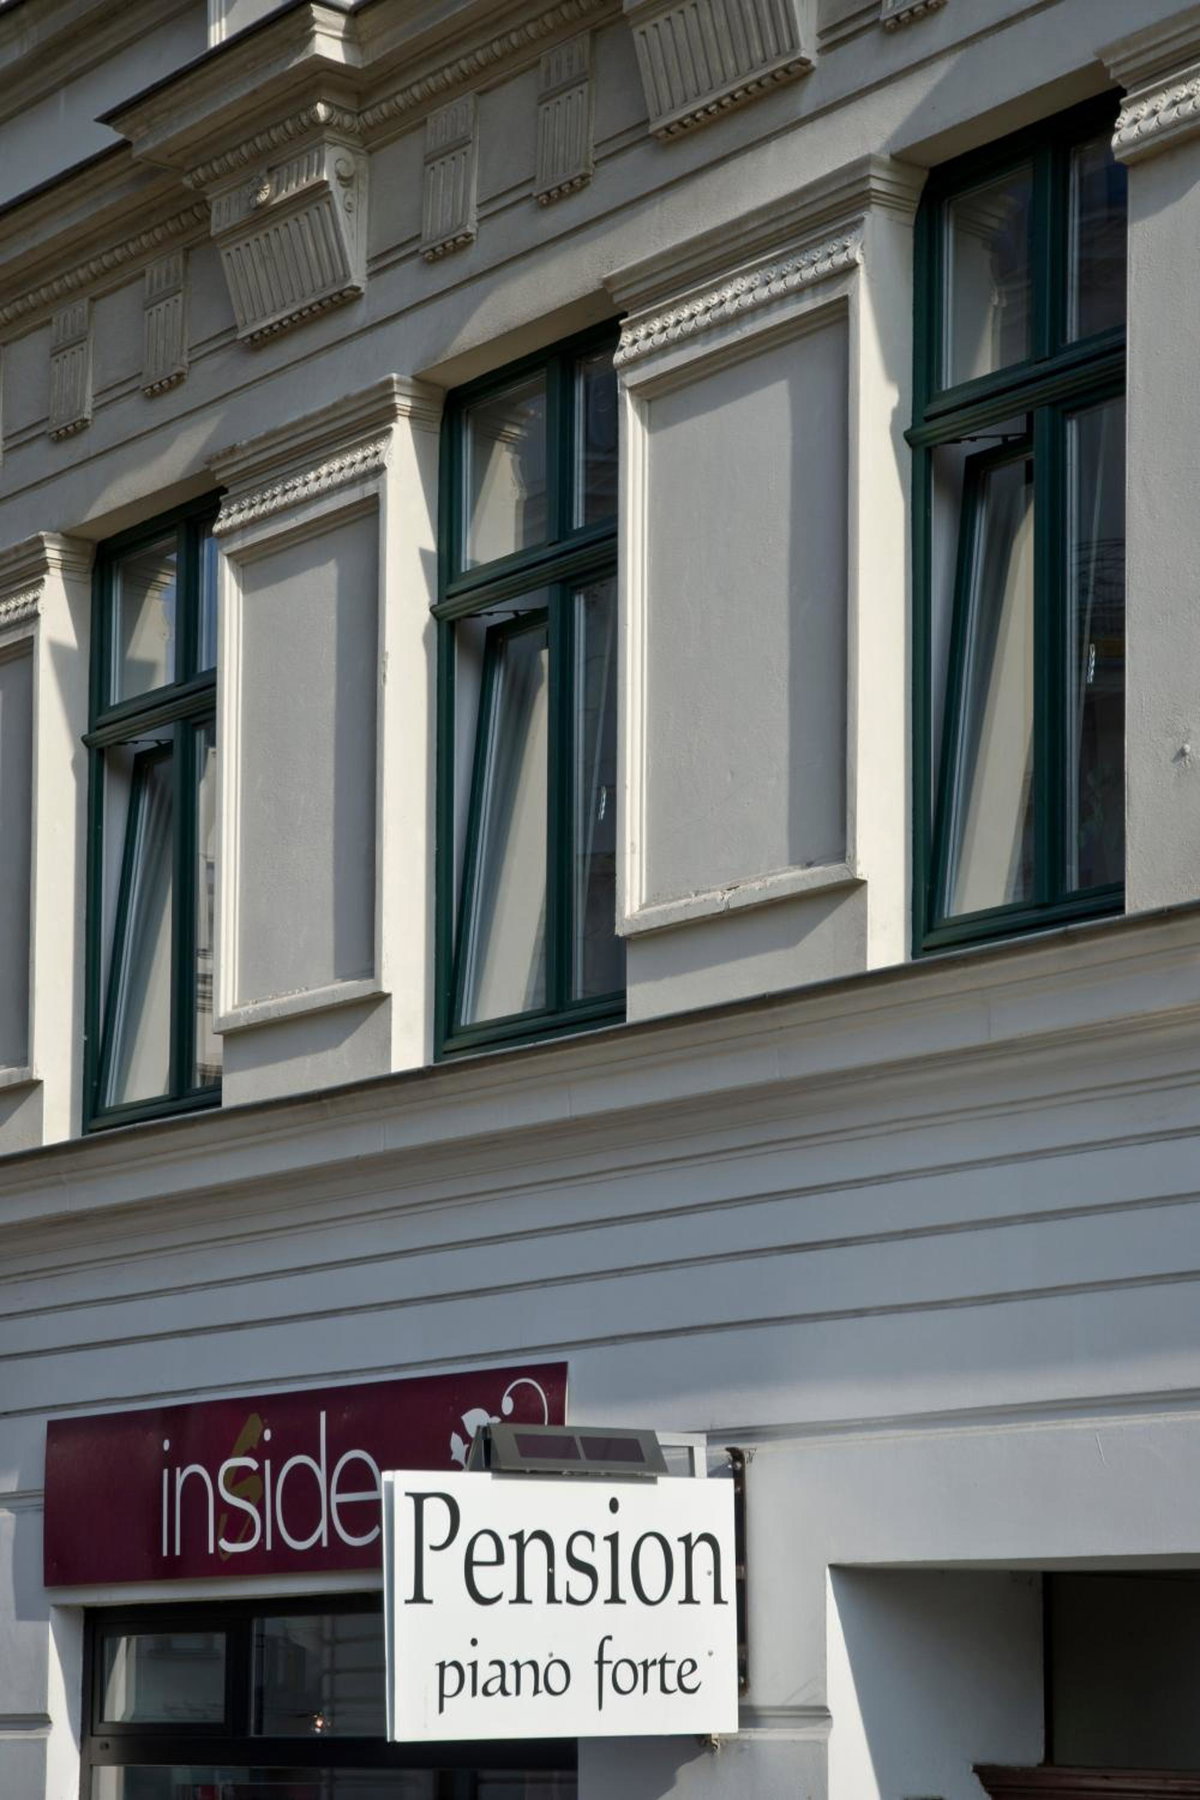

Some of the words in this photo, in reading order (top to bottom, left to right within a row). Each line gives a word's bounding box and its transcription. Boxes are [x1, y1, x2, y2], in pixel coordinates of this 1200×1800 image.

[161, 1411, 381, 1557] inside
[404, 1491, 729, 1607] Pension
[434, 1637, 572, 1715] piano
[593, 1635, 702, 1711] forte
